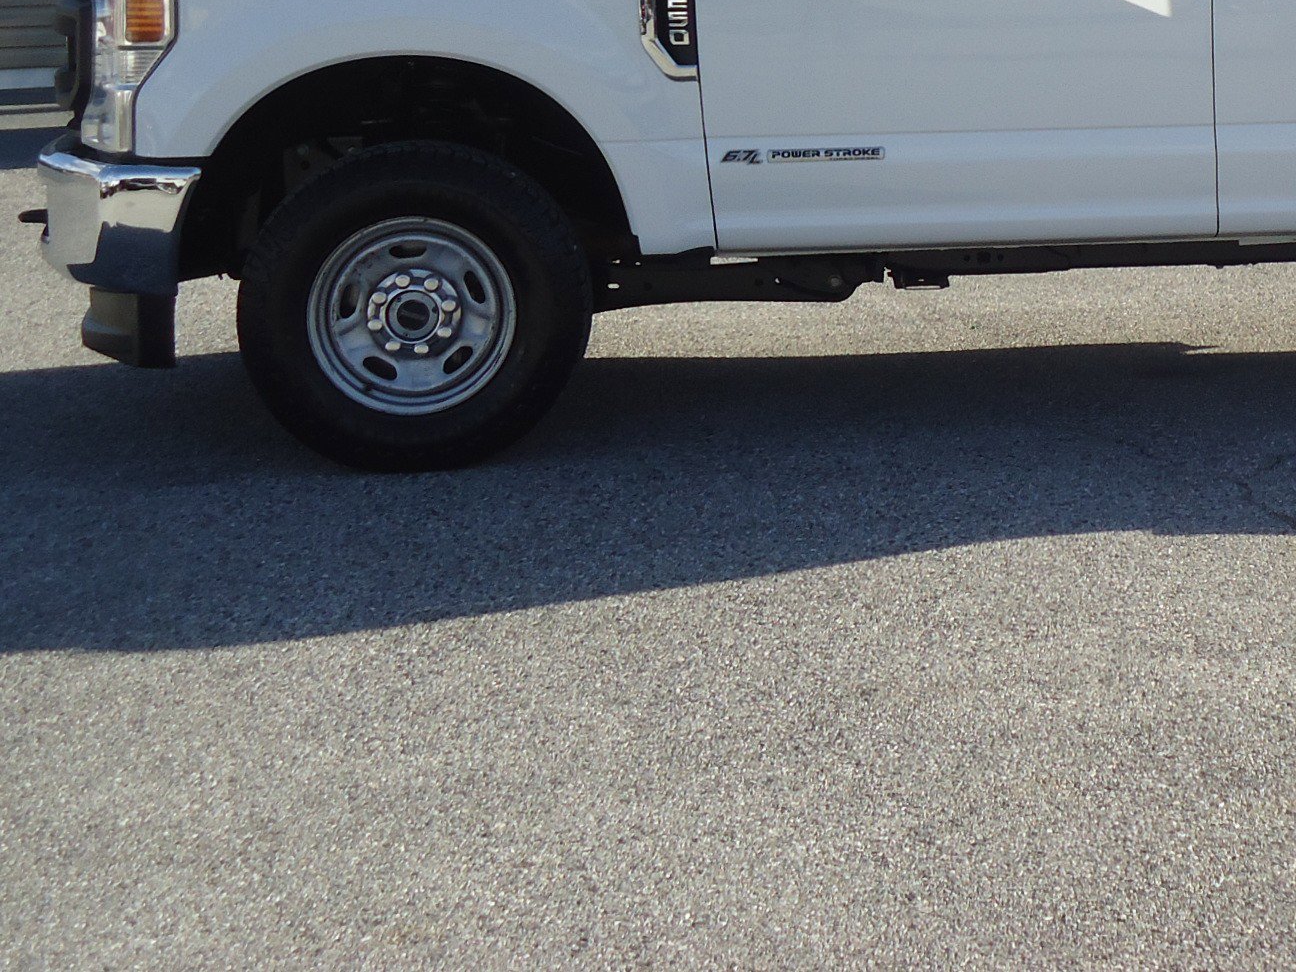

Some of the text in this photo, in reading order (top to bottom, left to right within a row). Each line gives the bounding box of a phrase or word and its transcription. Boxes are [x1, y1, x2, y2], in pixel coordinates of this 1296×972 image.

[720, 149, 764, 165] 6.7L
[771, 148, 821, 159] POWER
[824, 147, 880, 157] STROKE
